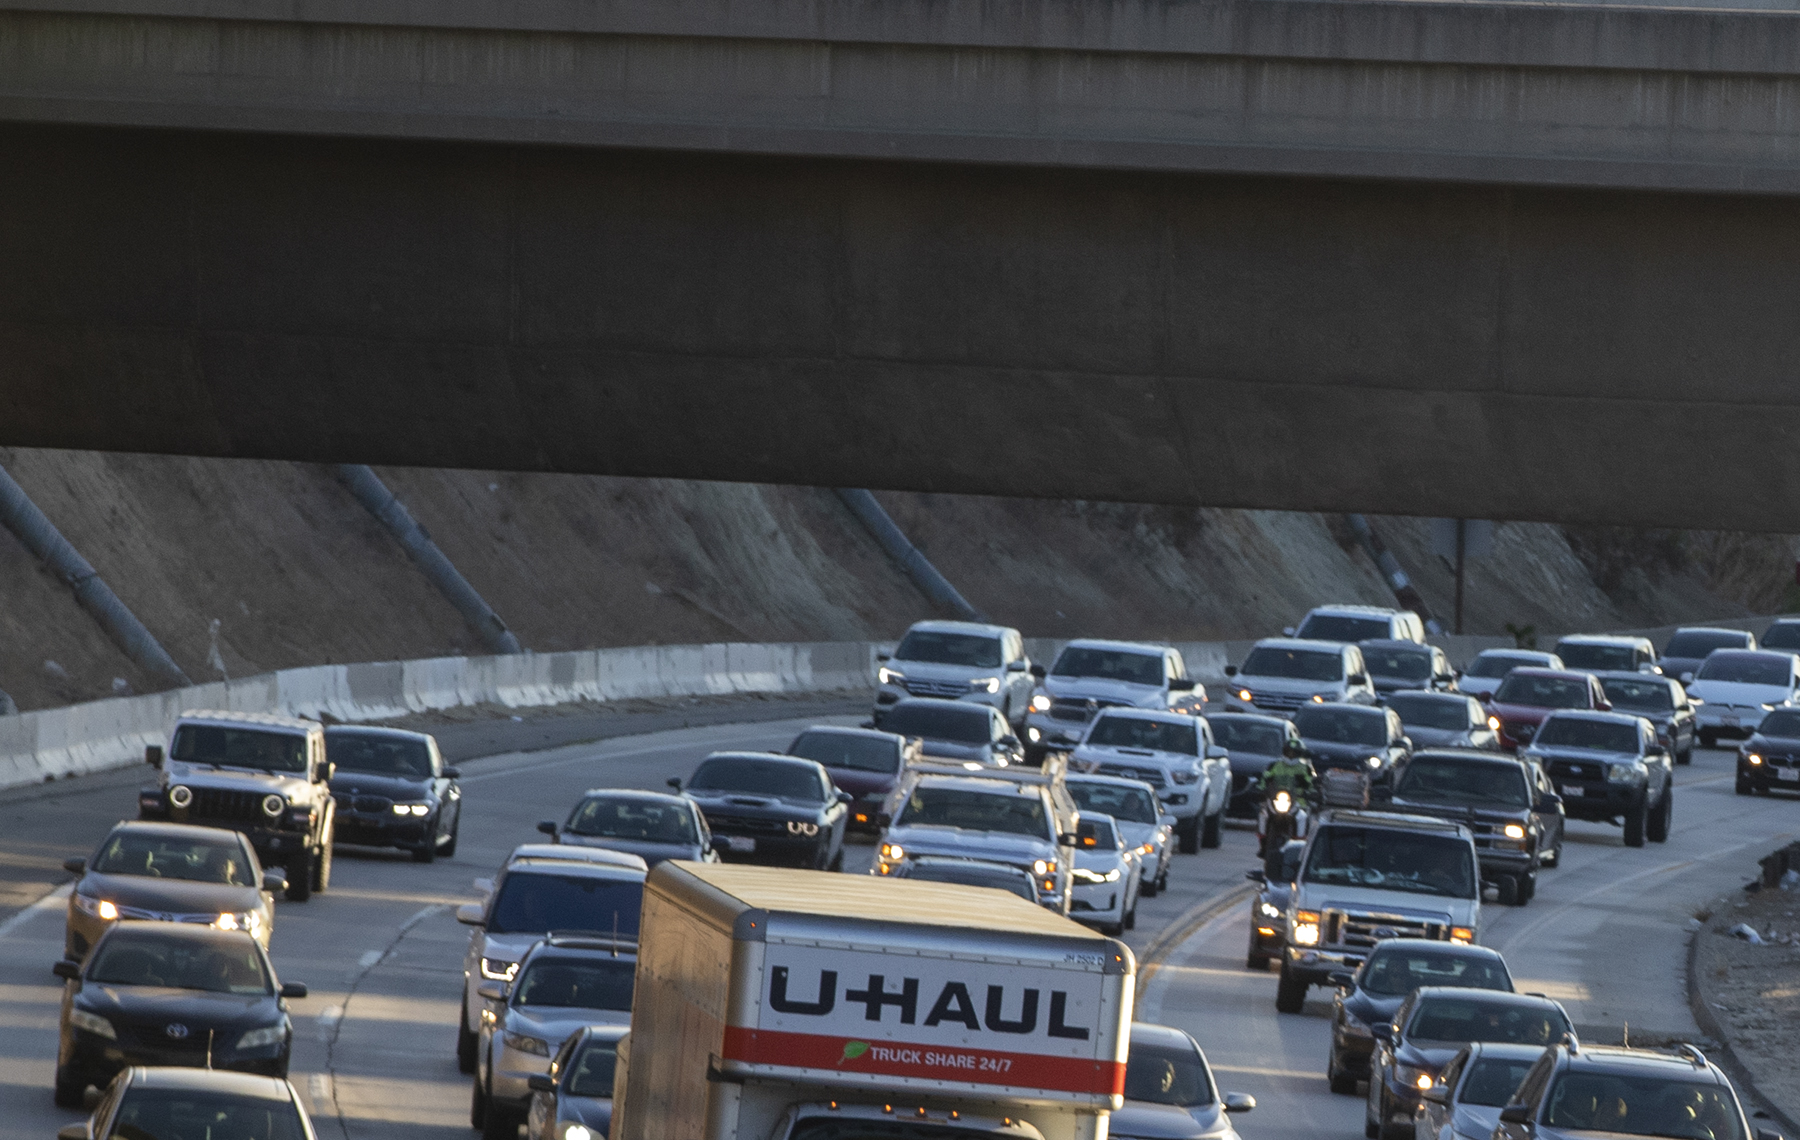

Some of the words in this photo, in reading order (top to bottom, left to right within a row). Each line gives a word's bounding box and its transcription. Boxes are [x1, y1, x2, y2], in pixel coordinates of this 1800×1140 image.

[769, 966, 1090, 1041] U-HAUL
[870, 1046, 921, 1064] TRUCK
[925, 1051, 976, 1069] SHARE
[979, 1056, 1012, 1073] 24/7
